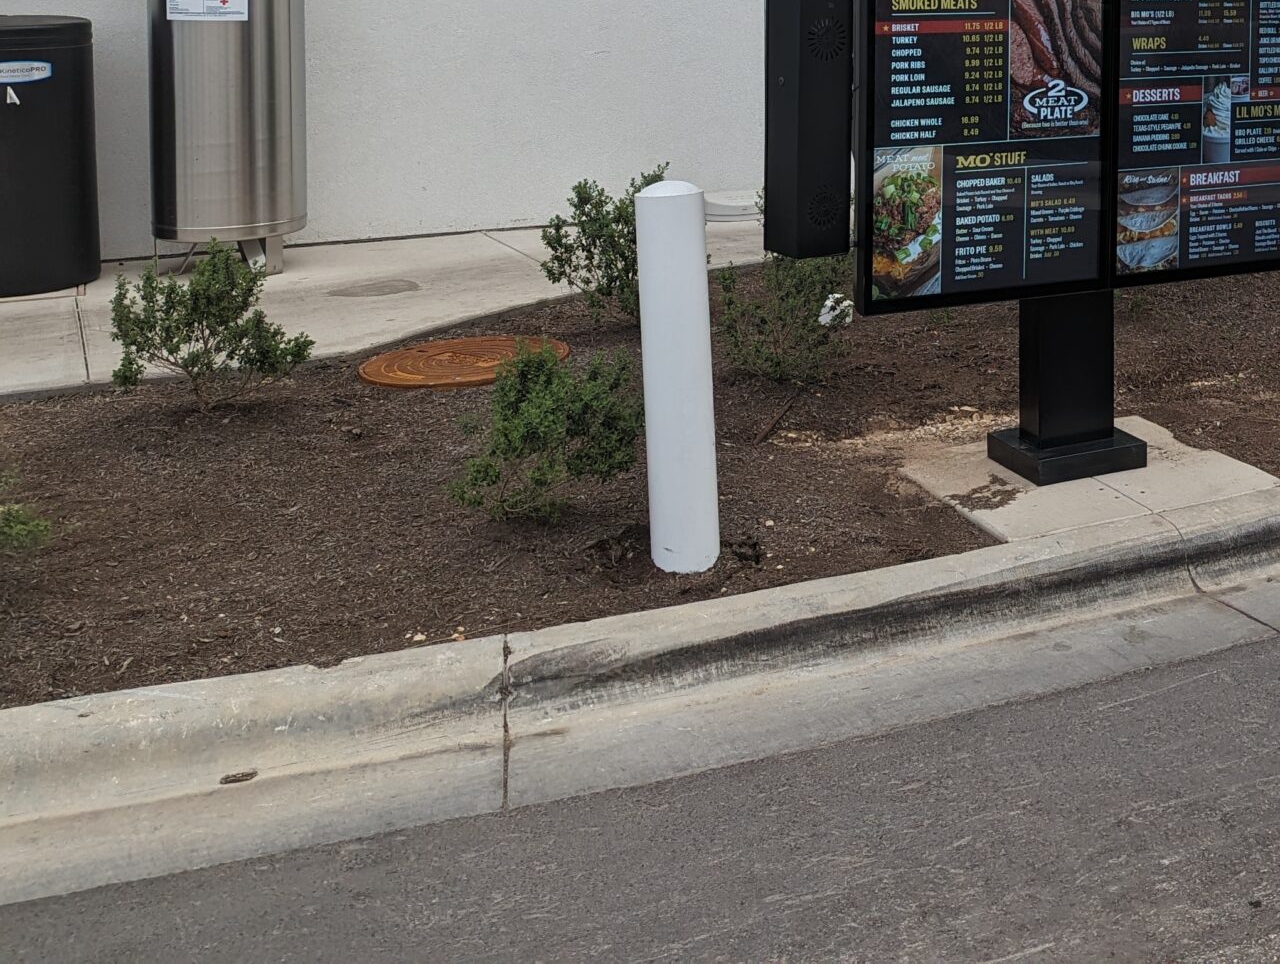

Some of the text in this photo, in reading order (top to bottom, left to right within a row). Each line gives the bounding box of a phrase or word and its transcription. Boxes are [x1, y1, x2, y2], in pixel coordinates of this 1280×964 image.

[891, 24, 919, 32] BRISKET
[1132, 37, 1166, 50] WRAPS
[892, 49, 922, 57] CHOPPED
[891, 61, 909, 70] PORK
[891, 86, 921, 94] REGULAR
[922, 85, 951, 93] SAUSAGE
[1048, 80, 1065, 96] 2
[1133, 88, 1180, 102] DESSERTS
[891, 98, 925, 107] JALAPENO
[1035, 96, 1078, 107] MEAT
[1041, 106, 1073, 119] PLATE
[1236, 106, 1249, 118] LIL
[1250, 105, 1272, 117] MO'S
[891, 118, 942, 127] CHICKEN WHOLE
[891, 131, 919, 140] CHICKEN
[876, 155, 909, 163] MEAT
[994, 151, 1026, 165] STUFF
[893, 162, 935, 172] POTATO
[957, 177, 1005, 188] CHOPPED BAKER
[1031, 174, 1054, 182] SALADS
[1190, 171, 1240, 186] BREAKFAST
[956, 214, 1000, 225] BAKED POTATO
[1190, 225, 1215, 233] BREAKFAST
[956, 246, 986, 256] FRITO PIE
